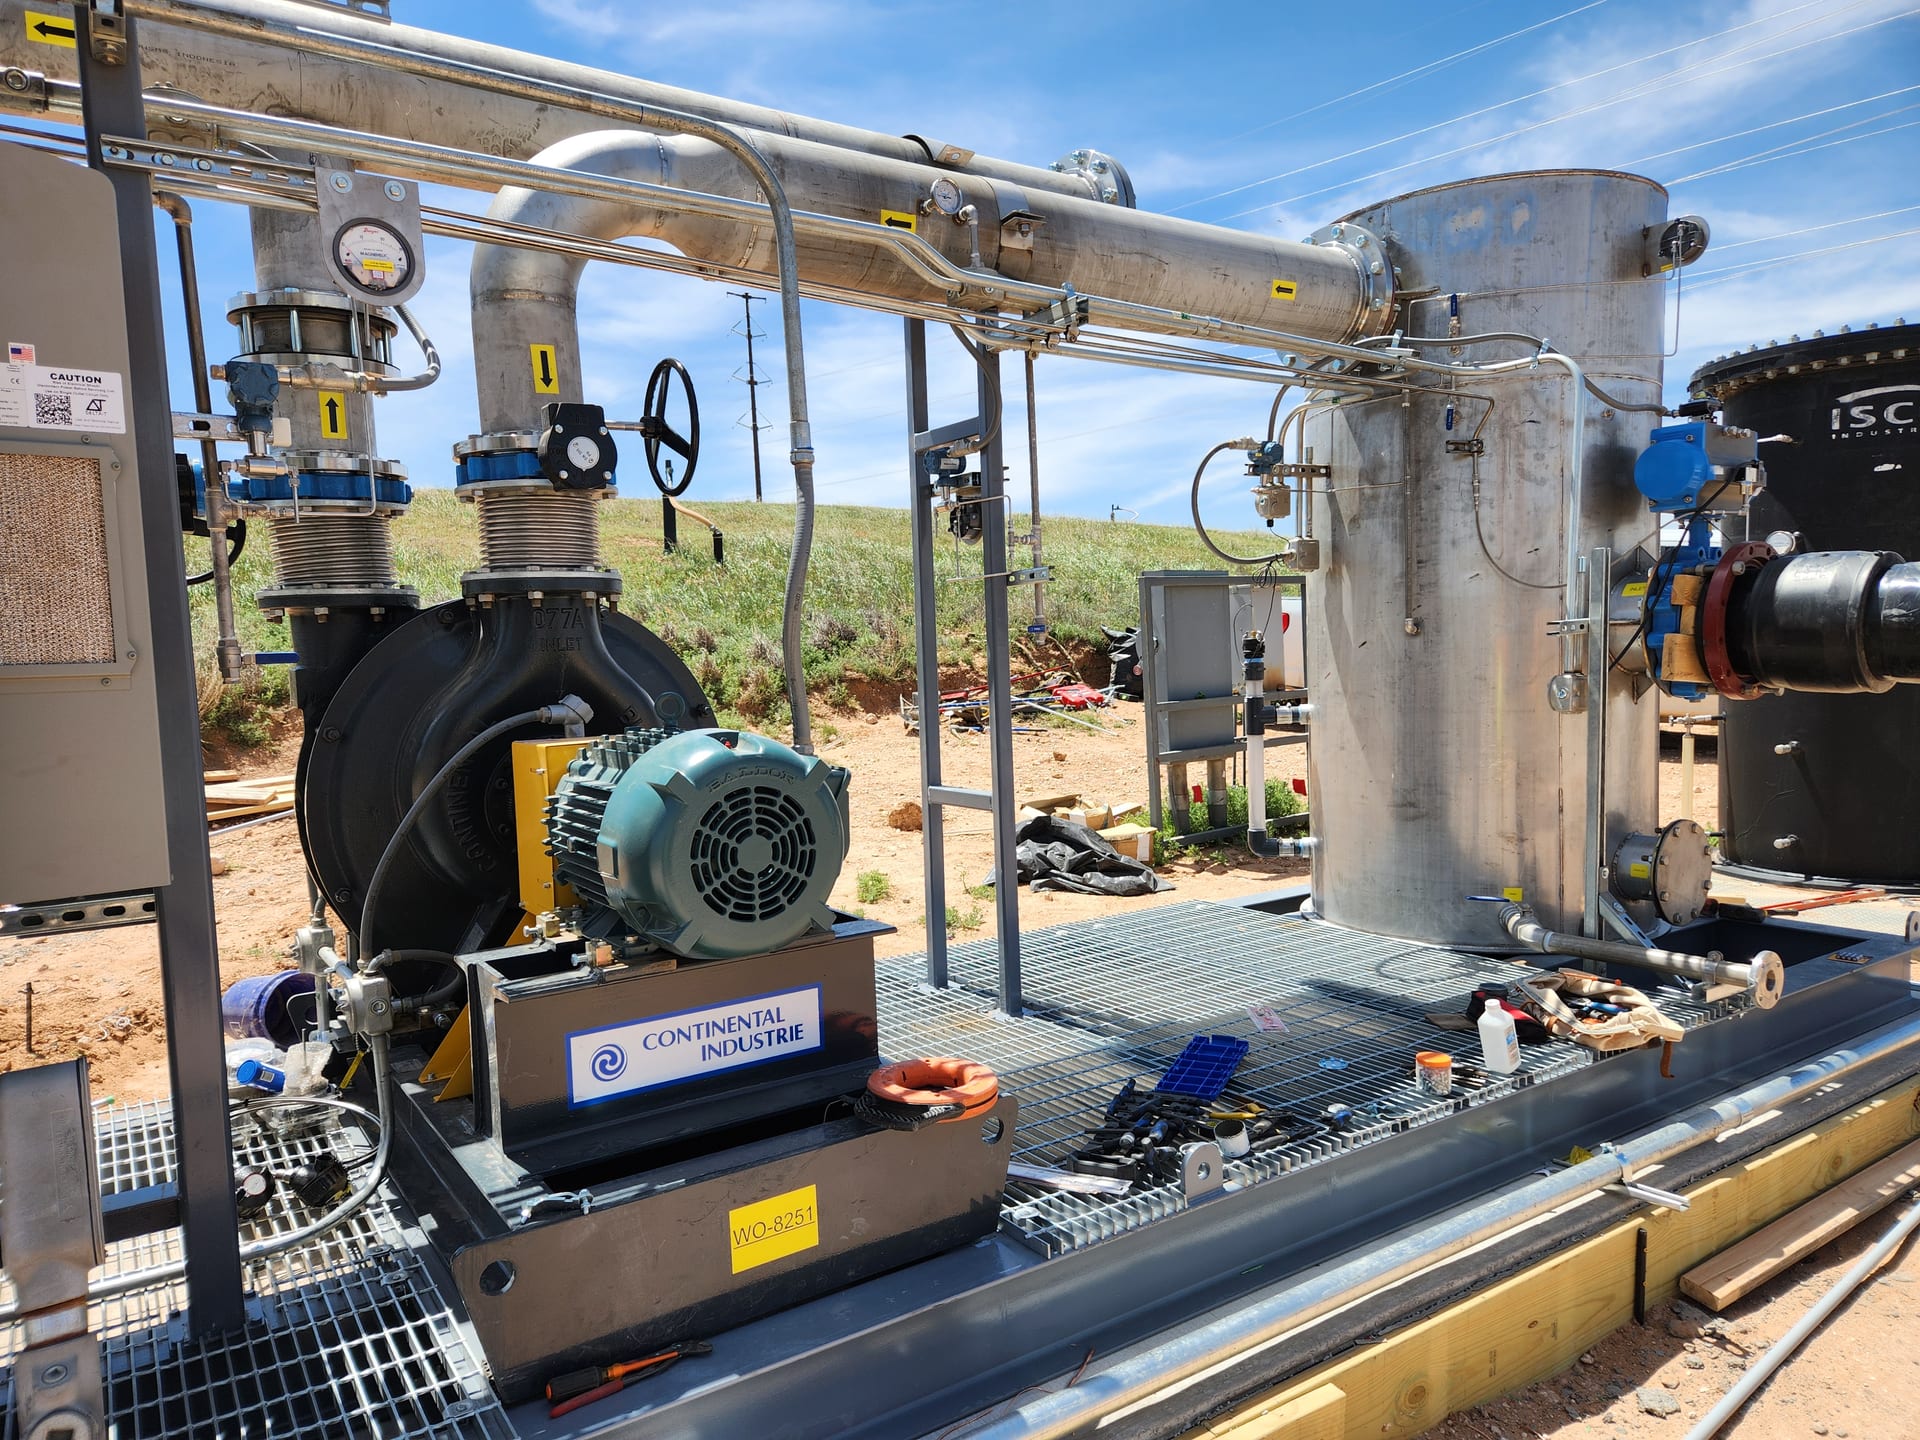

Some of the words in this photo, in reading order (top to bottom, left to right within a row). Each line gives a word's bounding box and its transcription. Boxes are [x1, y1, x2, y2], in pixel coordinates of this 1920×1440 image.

[50, 372, 102, 384] CAUTION
[706, 765, 795, 793] BALDOR
[642, 1006, 786, 1051] CONTINENTAL
[701, 1023, 804, 1062] INDUSTRIE
[733, 1205, 814, 1246] WO-8251
